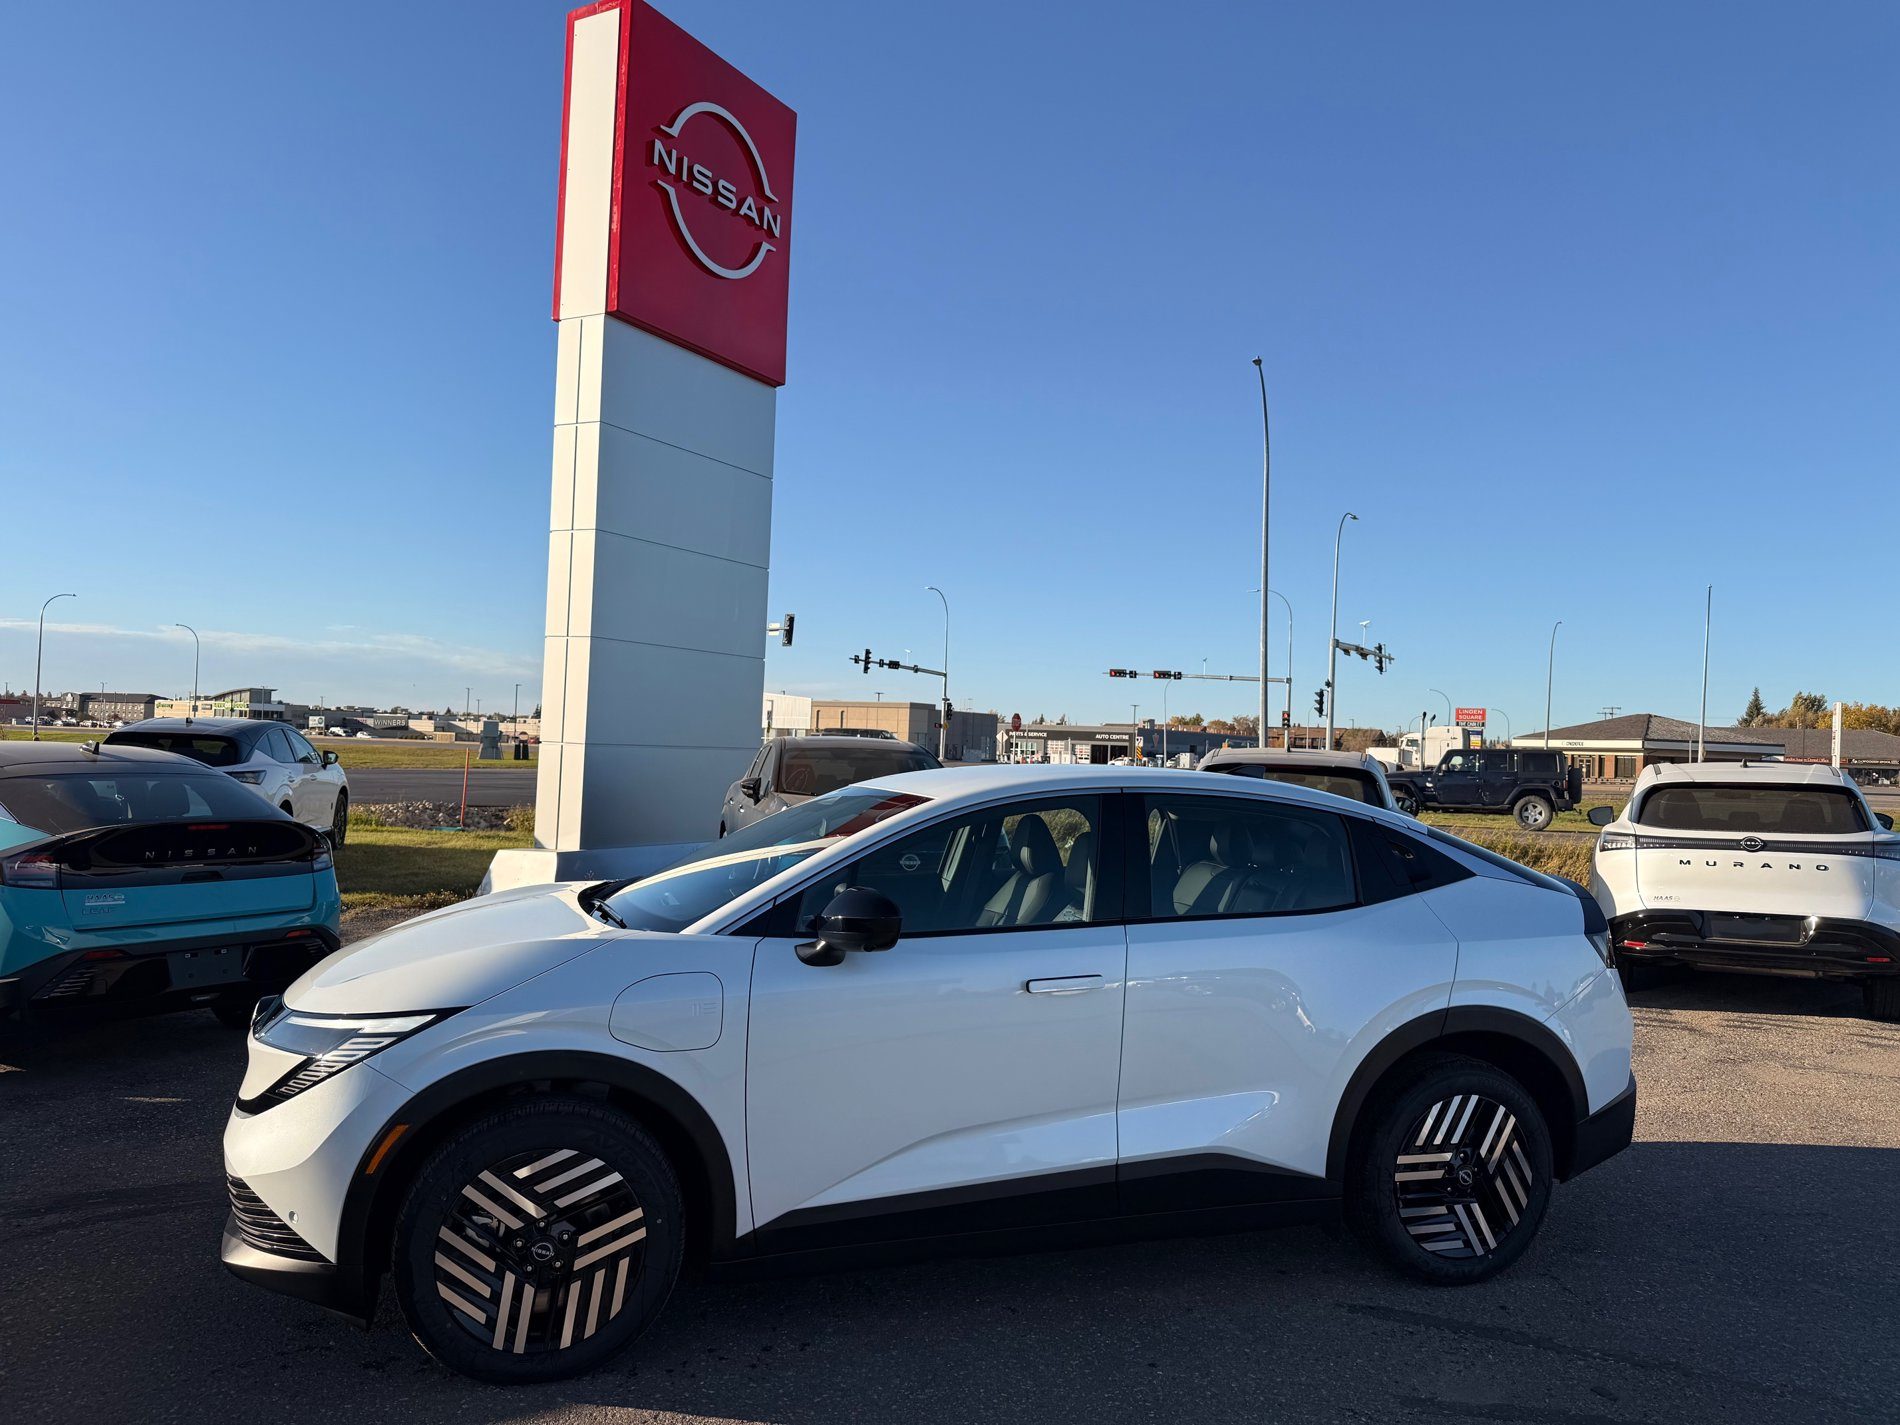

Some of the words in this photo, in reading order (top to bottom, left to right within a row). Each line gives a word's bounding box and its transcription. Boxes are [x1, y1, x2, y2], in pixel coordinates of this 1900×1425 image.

[653, 138, 781, 238] NISSAN
[374, 719, 406, 727] WINNERS
[145, 846, 257, 859] NISSAN
[1679, 859, 1830, 872] MURANO
